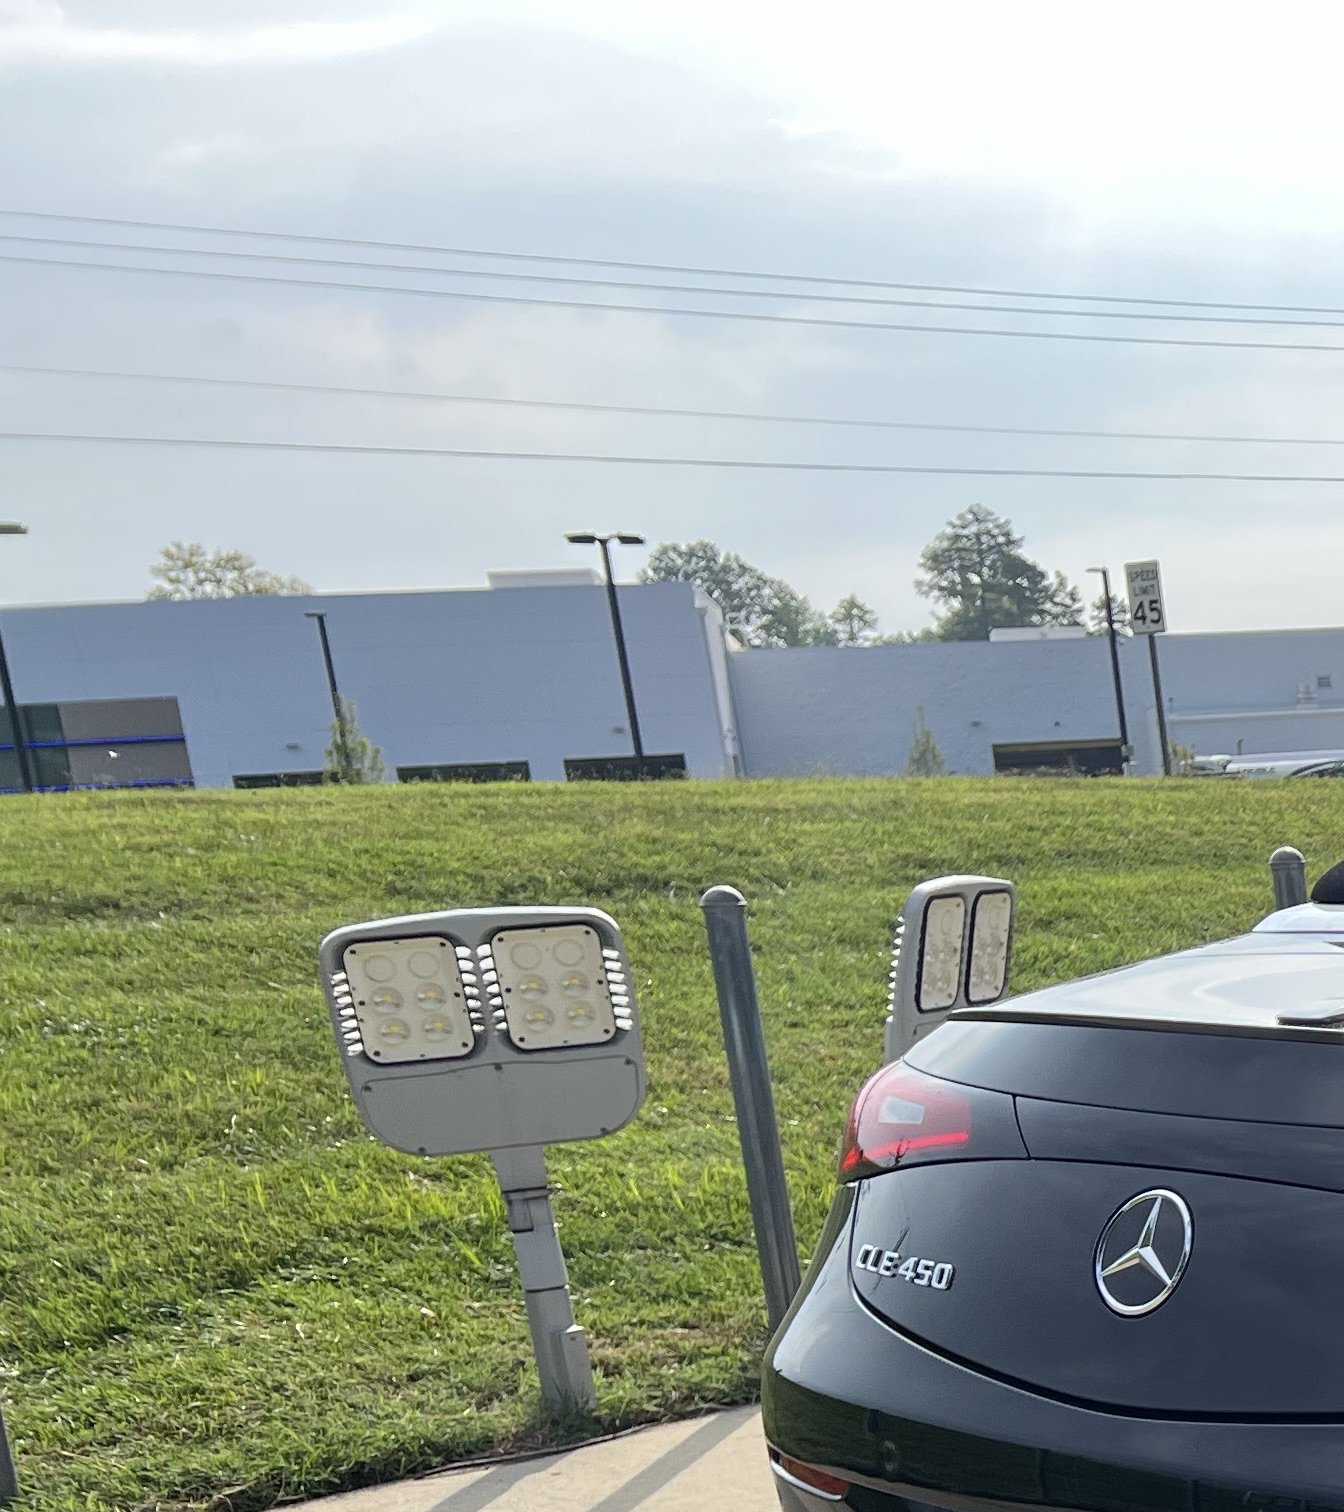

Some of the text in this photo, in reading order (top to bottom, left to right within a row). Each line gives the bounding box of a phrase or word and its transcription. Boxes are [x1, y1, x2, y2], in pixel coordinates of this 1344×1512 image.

[1133, 599, 1162, 626] 45
[855, 1244, 955, 1290] CLE 450
